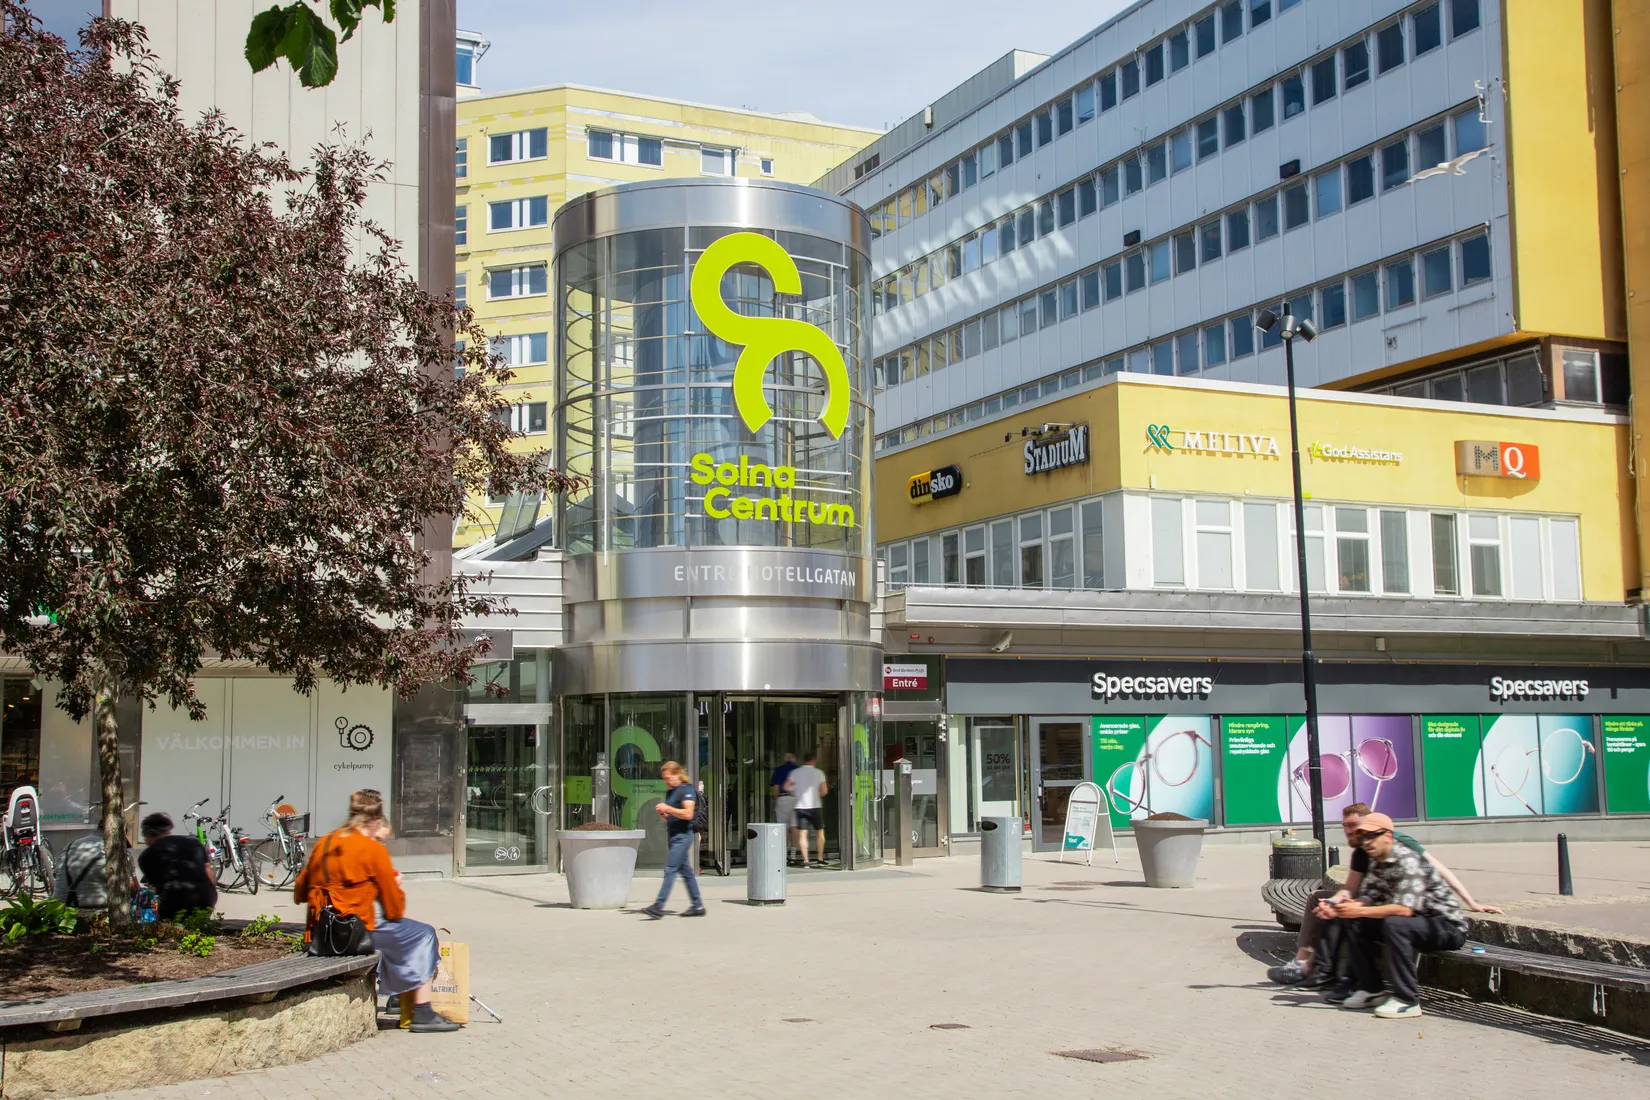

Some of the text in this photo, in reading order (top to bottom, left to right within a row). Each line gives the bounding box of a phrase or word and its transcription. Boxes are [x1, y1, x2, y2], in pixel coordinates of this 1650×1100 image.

[1182, 429, 1281, 457] MELIVA
[1322, 443, 1403, 462] God Assistans
[690, 452, 796, 489] Solna
[703, 486, 855, 528] Centrum
[892, 678, 918, 687] Entré
[1092, 672, 1213, 697] Specsavers
[1490, 676, 1590, 699] Specsavers
[156, 732, 305, 751] VÄLKOMMEN IN
[333, 761, 374, 772] cykelpump
[986, 753, 1011, 765] 50%
